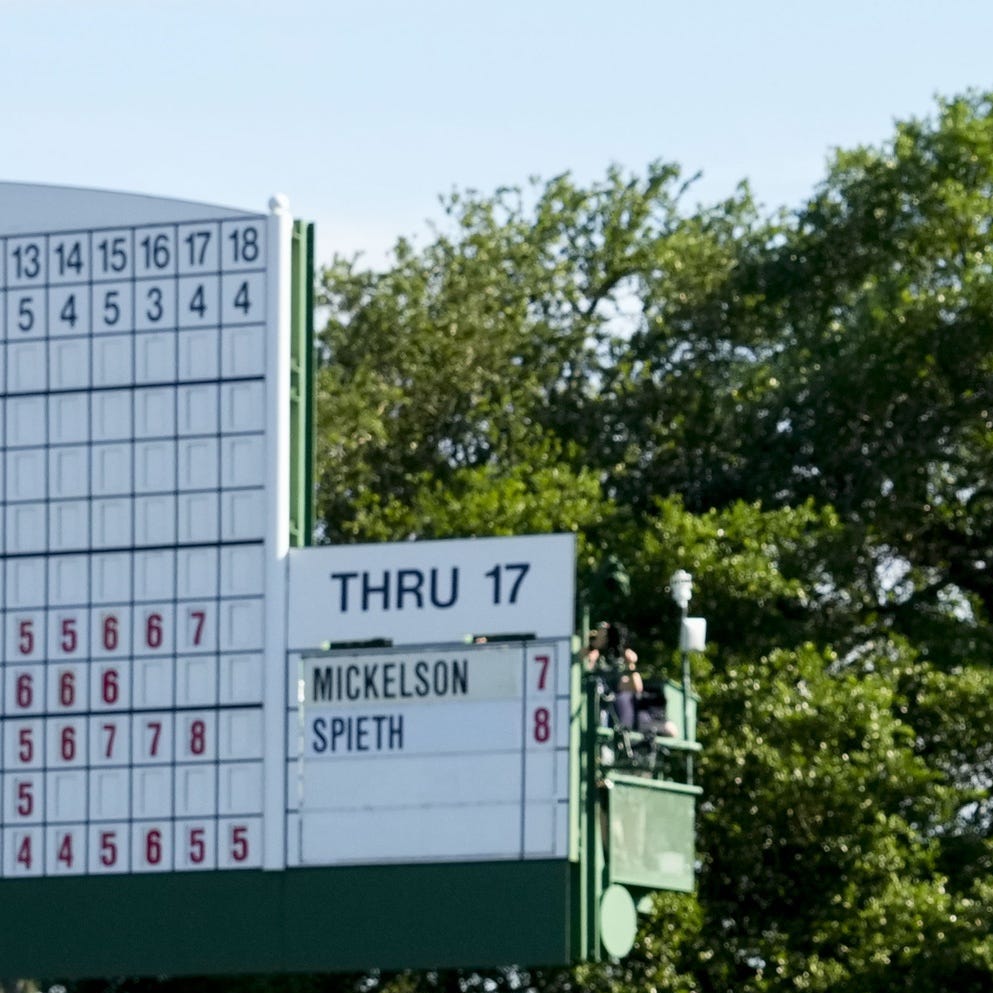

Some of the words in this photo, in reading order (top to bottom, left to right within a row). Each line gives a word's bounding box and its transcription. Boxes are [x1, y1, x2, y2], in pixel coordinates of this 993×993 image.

[12, 244, 40, 279] 13
[55, 242, 82, 275] 14
[98, 238, 127, 272] 15
[140, 234, 170, 269] 16
[184, 232, 211, 266] 17
[229, 227, 259, 262] 18
[17, 298, 34, 332] 5
[59, 294, 78, 328] 4
[103, 291, 120, 325] 5
[146, 288, 163, 322] 3
[189, 285, 206, 318] 4
[233, 282, 250, 314] 4
[331, 566, 459, 613] THRU
[486, 563, 530, 604] 17
[19, 621, 34, 654] 5
[62, 619, 77, 653] 5
[104, 616, 118, 651] 6
[147, 614, 162, 648] 6
[191, 612, 205, 646] 7
[17, 674, 32, 708] 6
[60, 672, 75, 706] 6
[103, 670, 118, 704] 6
[313, 660, 469, 701] MICKELSON
[534, 656, 551, 690] 7
[19, 729, 33, 763] 5
[61, 726, 76, 761] 6
[104, 725, 116, 758] 7
[148, 722, 161, 756] 7
[190, 720, 205, 755] 8
[313, 715, 403, 753] SPIETH
[534, 708, 550, 743] 8
[18, 782, 33, 816] 5
[18, 836, 31, 870] 4
[58, 833, 73, 868] 4
[102, 832, 117, 866] 5
[146, 830, 162, 864] 6
[190, 829, 205, 863] 5
[232, 826, 248, 861] 5
